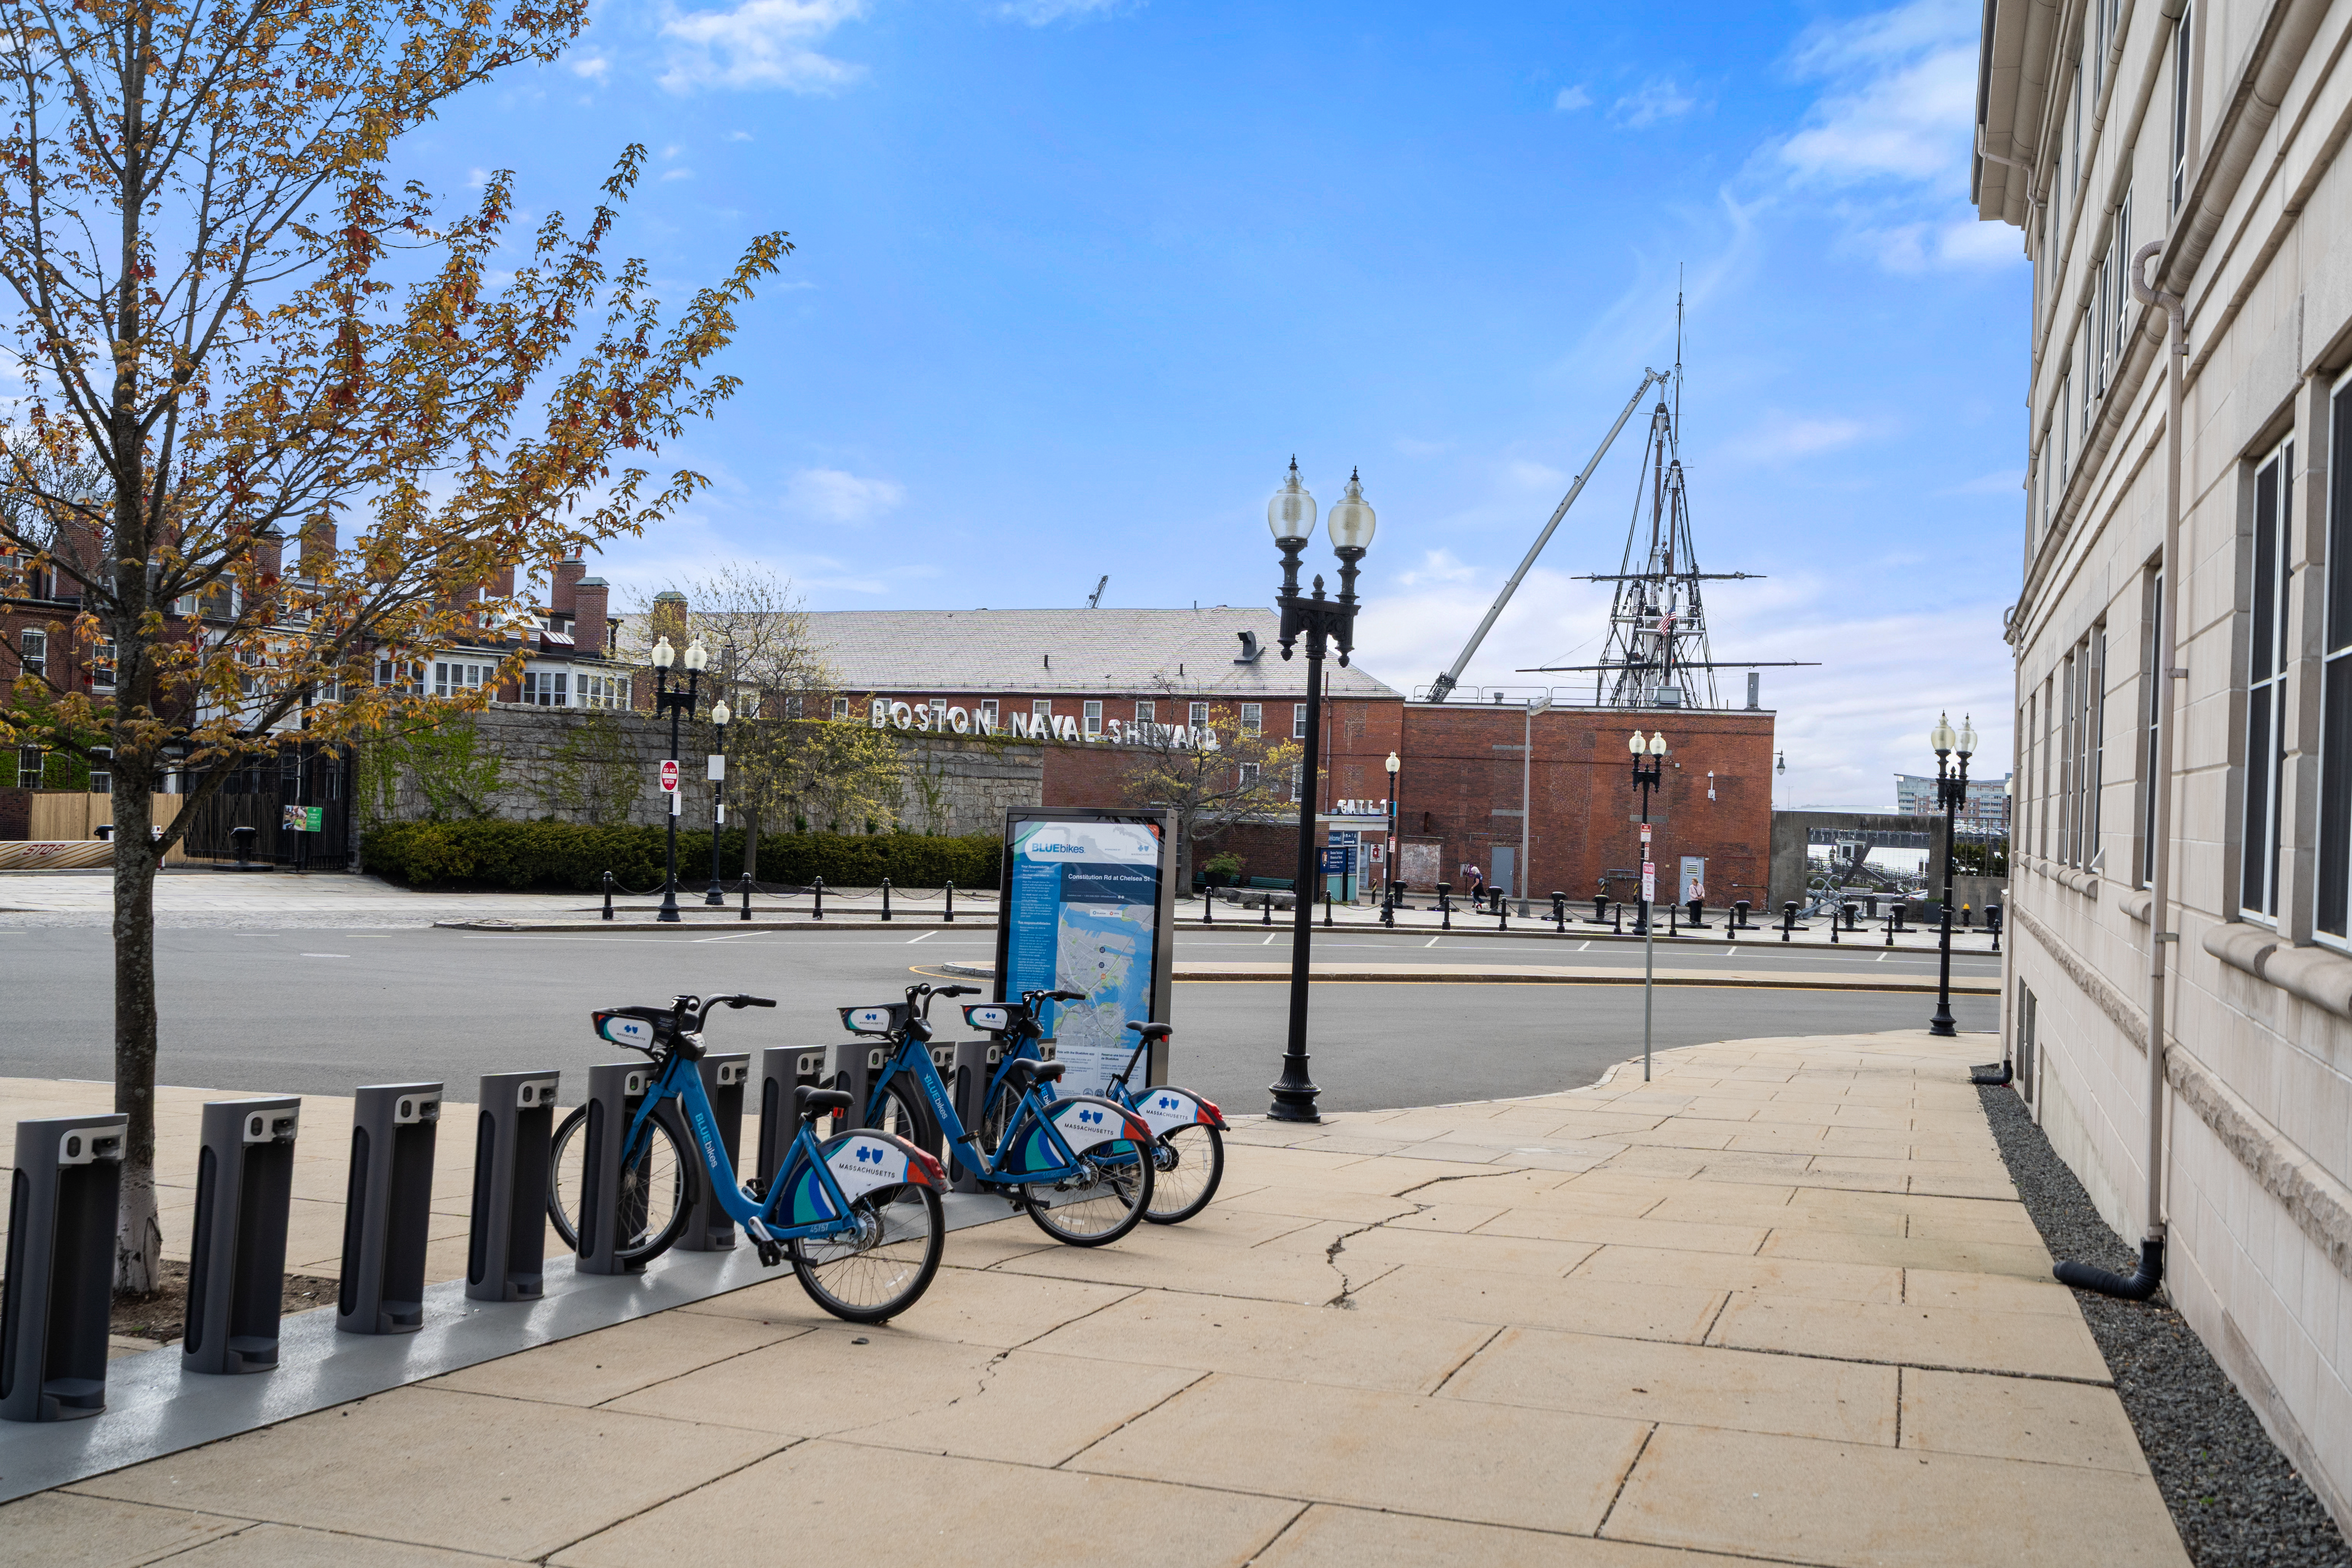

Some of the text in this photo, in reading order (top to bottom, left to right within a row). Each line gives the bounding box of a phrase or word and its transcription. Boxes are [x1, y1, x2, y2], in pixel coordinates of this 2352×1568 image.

[869, 701, 990, 736] BOSTON
[1008, 712, 1095, 742] NAVAL
[1337, 799, 1387, 814] GATE 1
[22, 844, 66, 855] STOP
[1032, 843, 1084, 853] BLUEbikes
[616, 1032, 646, 1041] MASSACHUSETTS
[924, 1075, 947, 1119] BLUEbikes
[1146, 1109, 1188, 1120] MASSACHUSETTS
[1064, 1123, 1114, 1135] MASSACHUSETTS
[695, 1112, 718, 1168] BLUEbikes
[838, 1163, 895, 1178] MASSACHUSETTS
